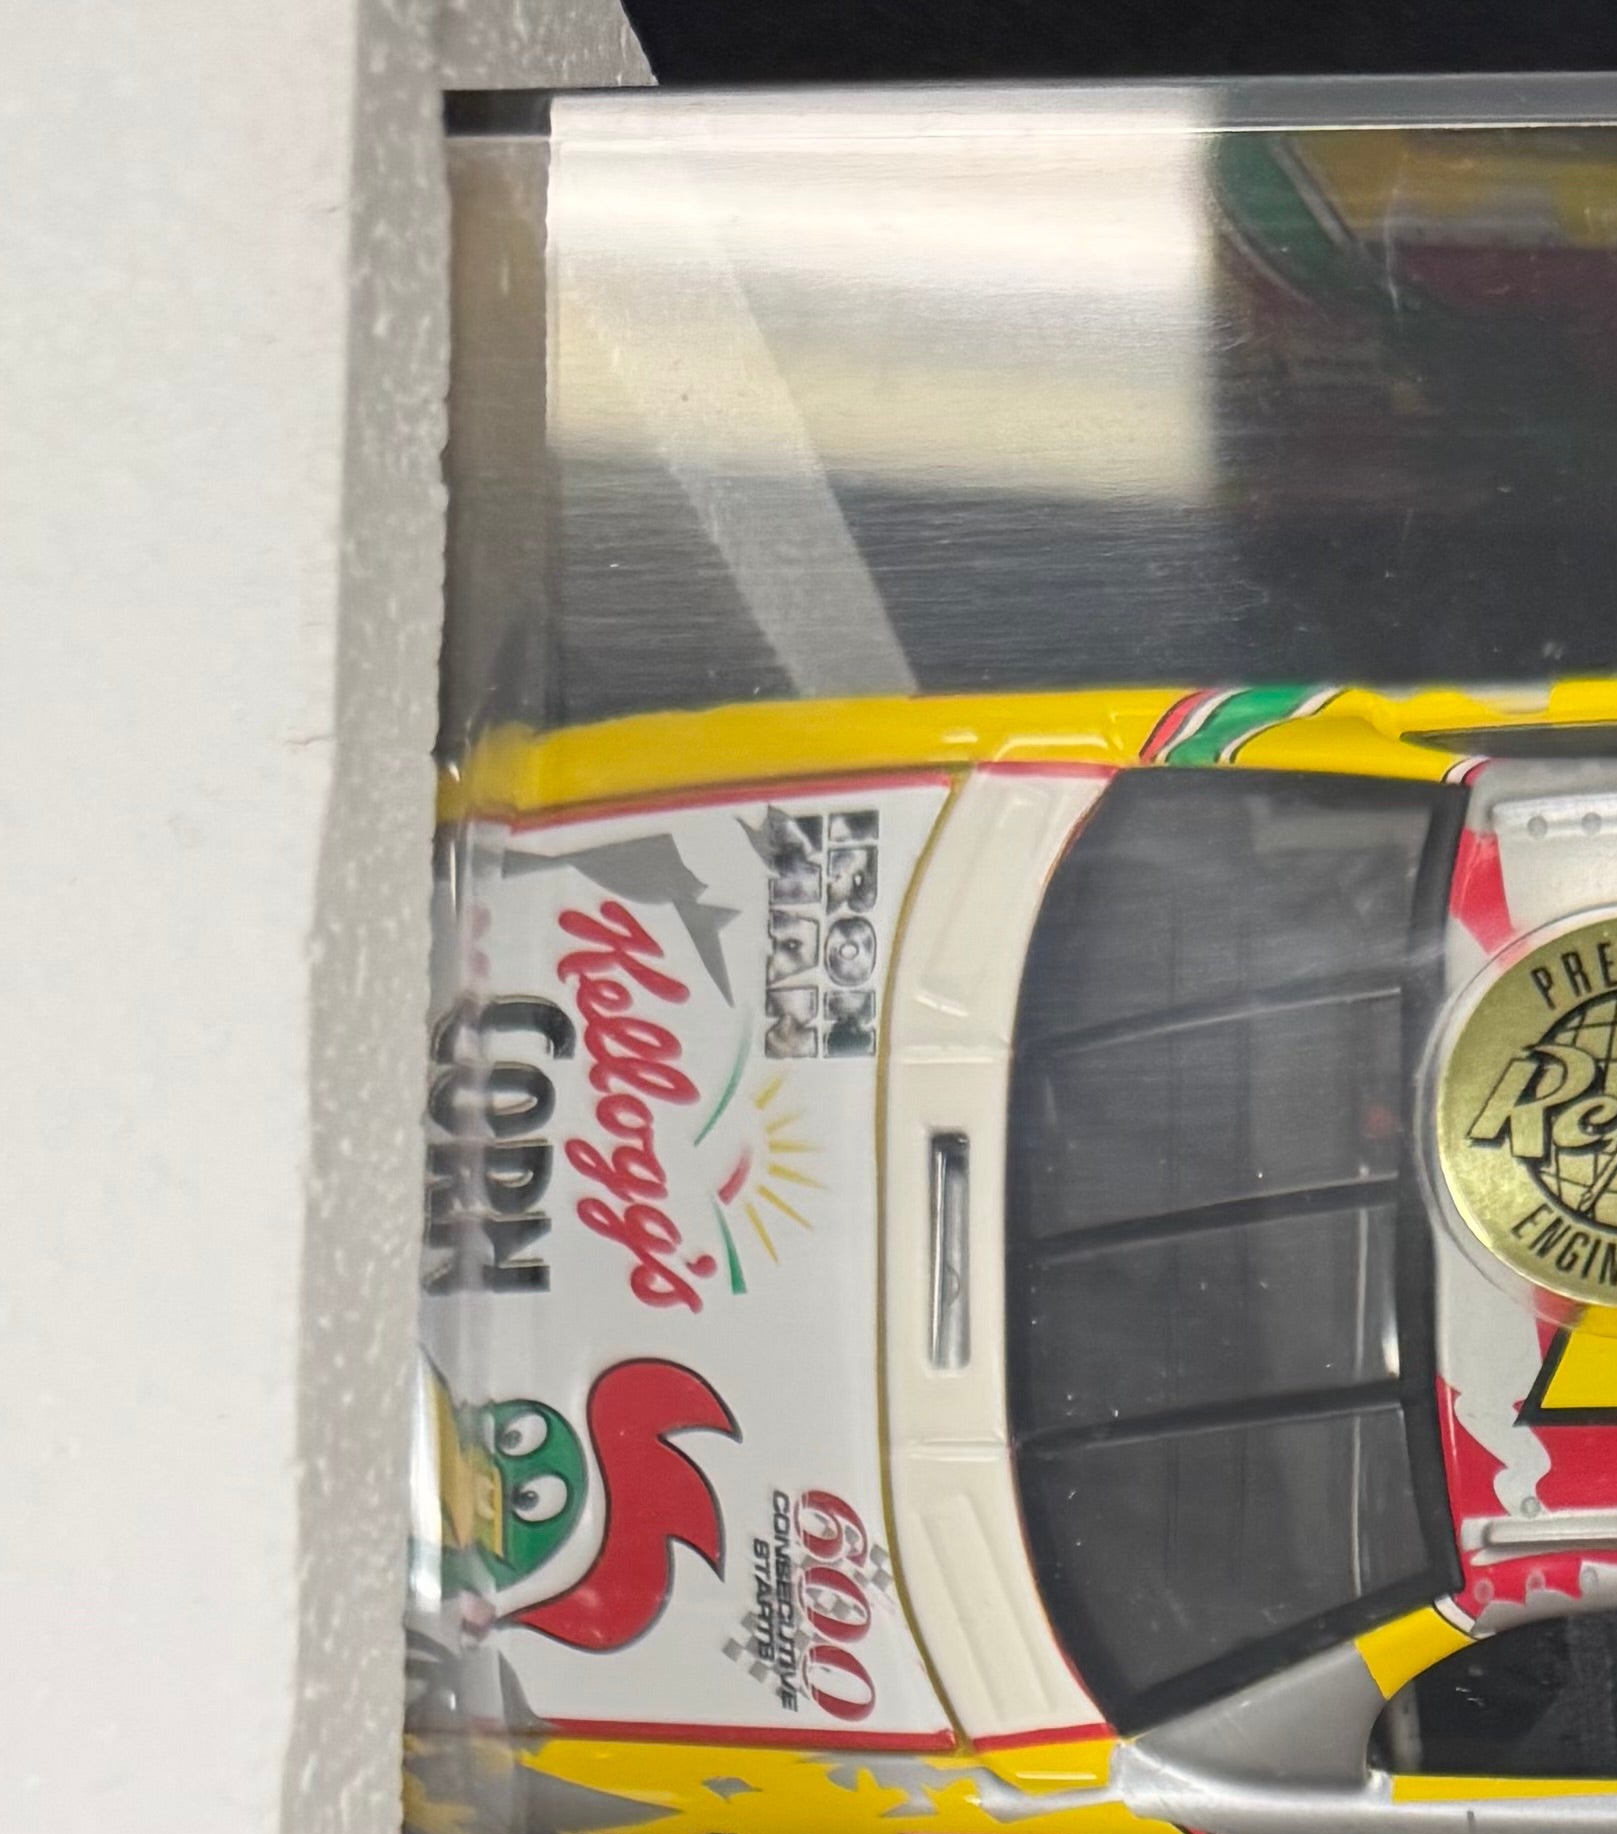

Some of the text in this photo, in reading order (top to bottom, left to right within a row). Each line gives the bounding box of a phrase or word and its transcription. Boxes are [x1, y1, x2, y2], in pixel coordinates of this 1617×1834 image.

[823, 810, 880, 1058] IRON
[556, 900, 717, 1315] Kellogg's
[753, 1537, 777, 1663] STARTS
[772, 1490, 799, 1712] CONSECUTIVE
[797, 1489, 878, 1722] 600
